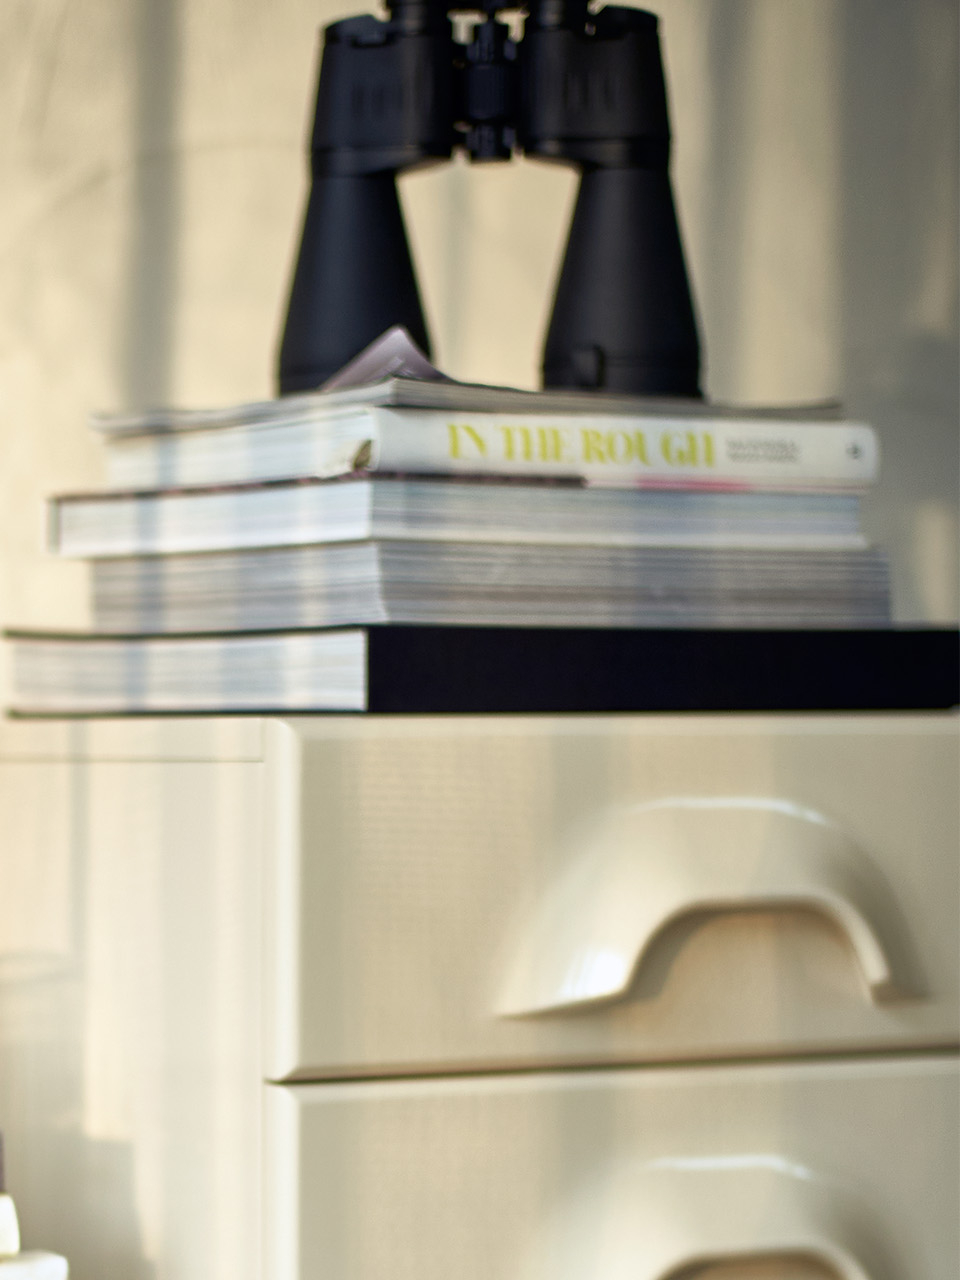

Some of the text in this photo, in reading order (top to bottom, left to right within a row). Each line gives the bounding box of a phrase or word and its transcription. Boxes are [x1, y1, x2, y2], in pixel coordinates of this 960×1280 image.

[447, 423, 488, 461] IN
[500, 425, 573, 464] THE
[580, 428, 716, 469] ROUGH
